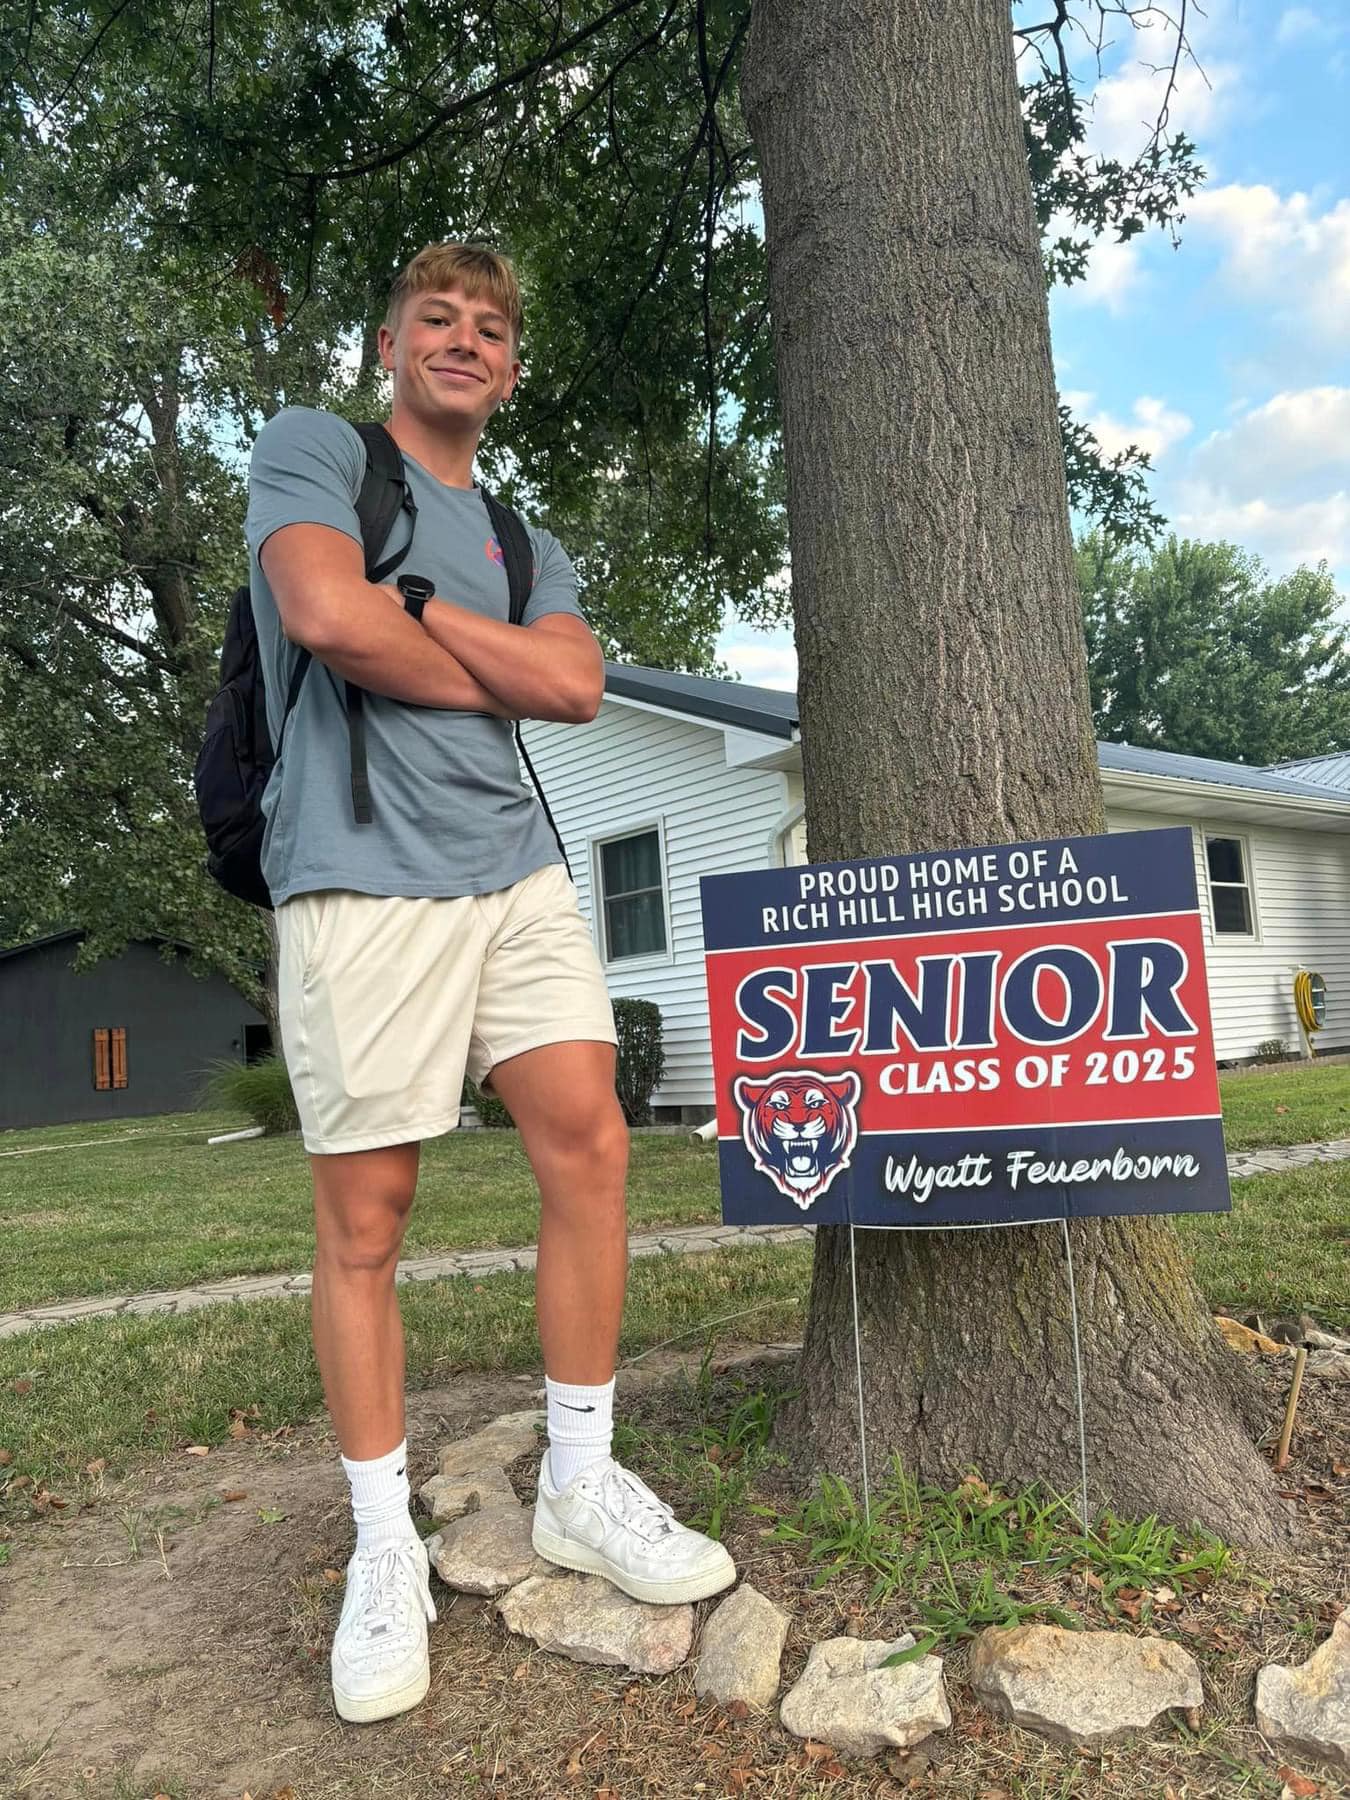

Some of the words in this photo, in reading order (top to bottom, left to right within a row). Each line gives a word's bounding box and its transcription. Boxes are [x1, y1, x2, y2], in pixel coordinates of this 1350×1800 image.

[800, 864, 900, 899] PROUD
[910, 854, 999, 889] HOME
[1008, 850, 1048, 878] OF
[1059, 847, 1079, 874] A
[762, 902, 829, 933] RICH
[838, 896, 905, 927] HILL
[913, 889, 988, 920] HIGH
[999, 875, 1128, 913] SCHOOL
[735, 937, 1199, 1063] SENIOR
[879, 1058, 1000, 1095] CLASS
[1015, 1054, 1071, 1087] OF
[1085, 1047, 1196, 1084] 2025
[885, 1153, 992, 1203] Wyatt
[1006, 1147, 1200, 1190] Feuerborn
